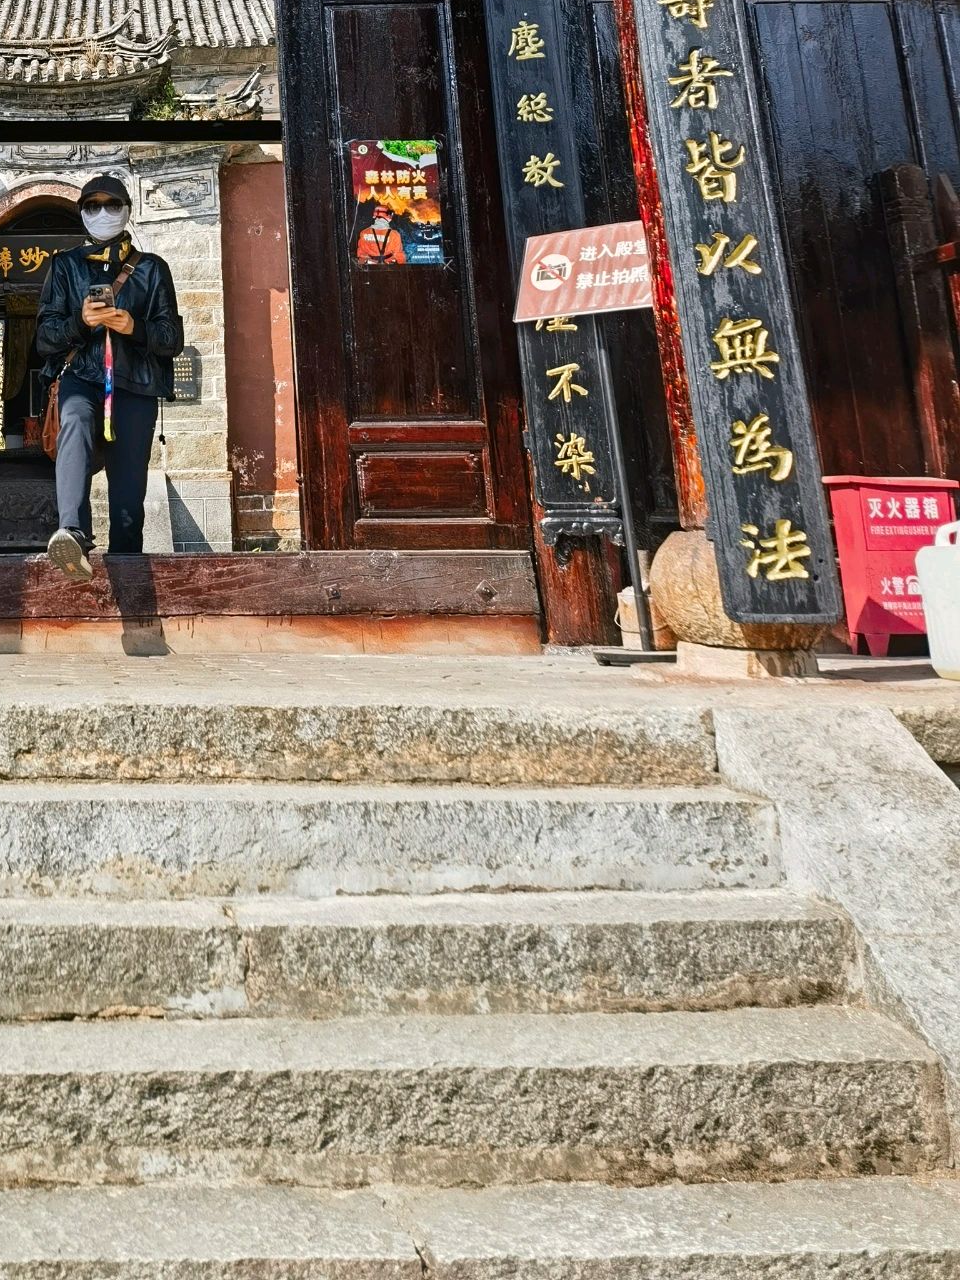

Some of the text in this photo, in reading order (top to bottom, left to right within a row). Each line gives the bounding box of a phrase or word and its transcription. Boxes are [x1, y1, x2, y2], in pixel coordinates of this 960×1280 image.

[365, 169, 427, 184] 森林防火
[367, 186, 428, 200] 人人有责
[579, 237, 648, 262] 进入殿堂
[575, 264, 649, 290] 禁止拍照
[867, 496, 940, 520] 灭火器箱
[880, 576, 905, 596] 火警
